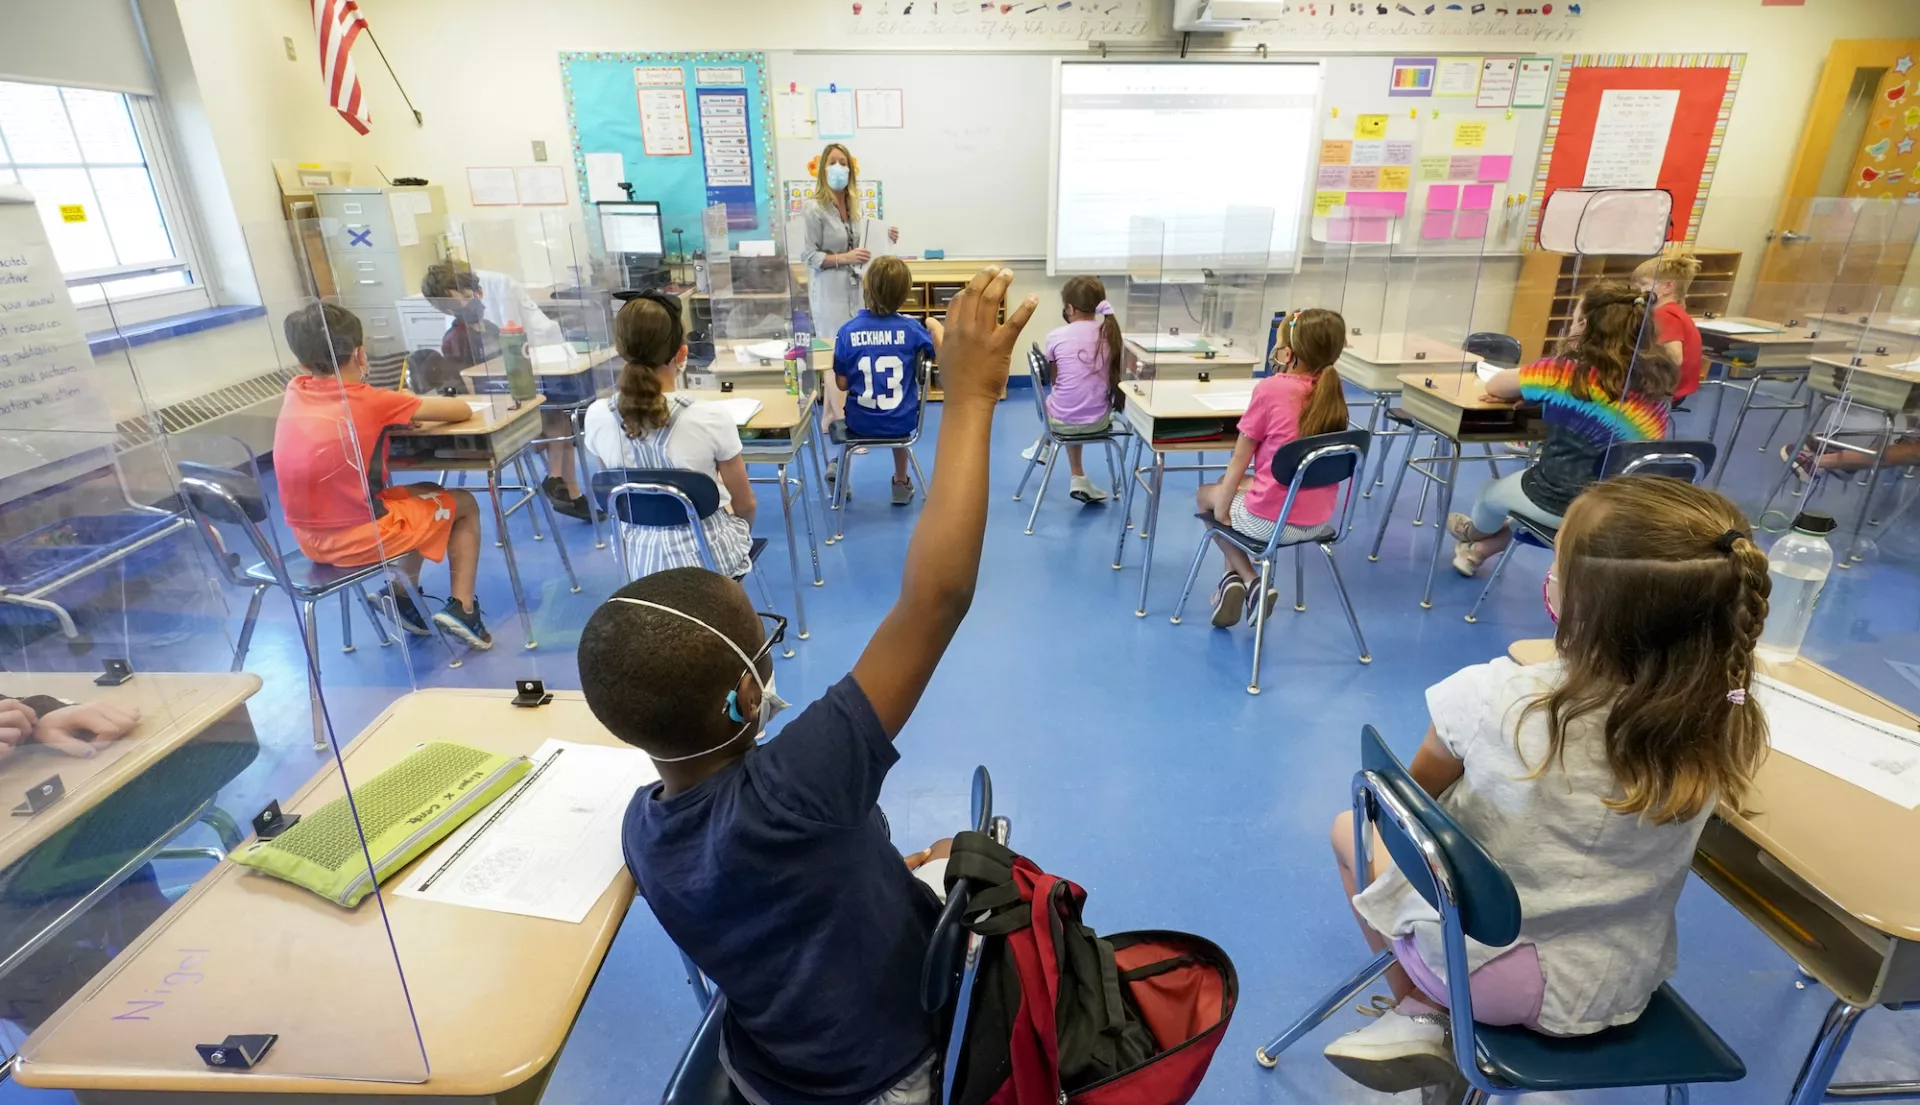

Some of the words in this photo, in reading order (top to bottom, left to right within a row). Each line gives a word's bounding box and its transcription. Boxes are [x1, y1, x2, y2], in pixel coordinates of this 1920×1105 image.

[850, 330, 893, 347] BECKHAM
[894, 330, 906, 345] JR
[857, 355, 904, 410] 13
[457, 771, 485, 791] Nigel
[110, 947, 211, 1021] Nigel
